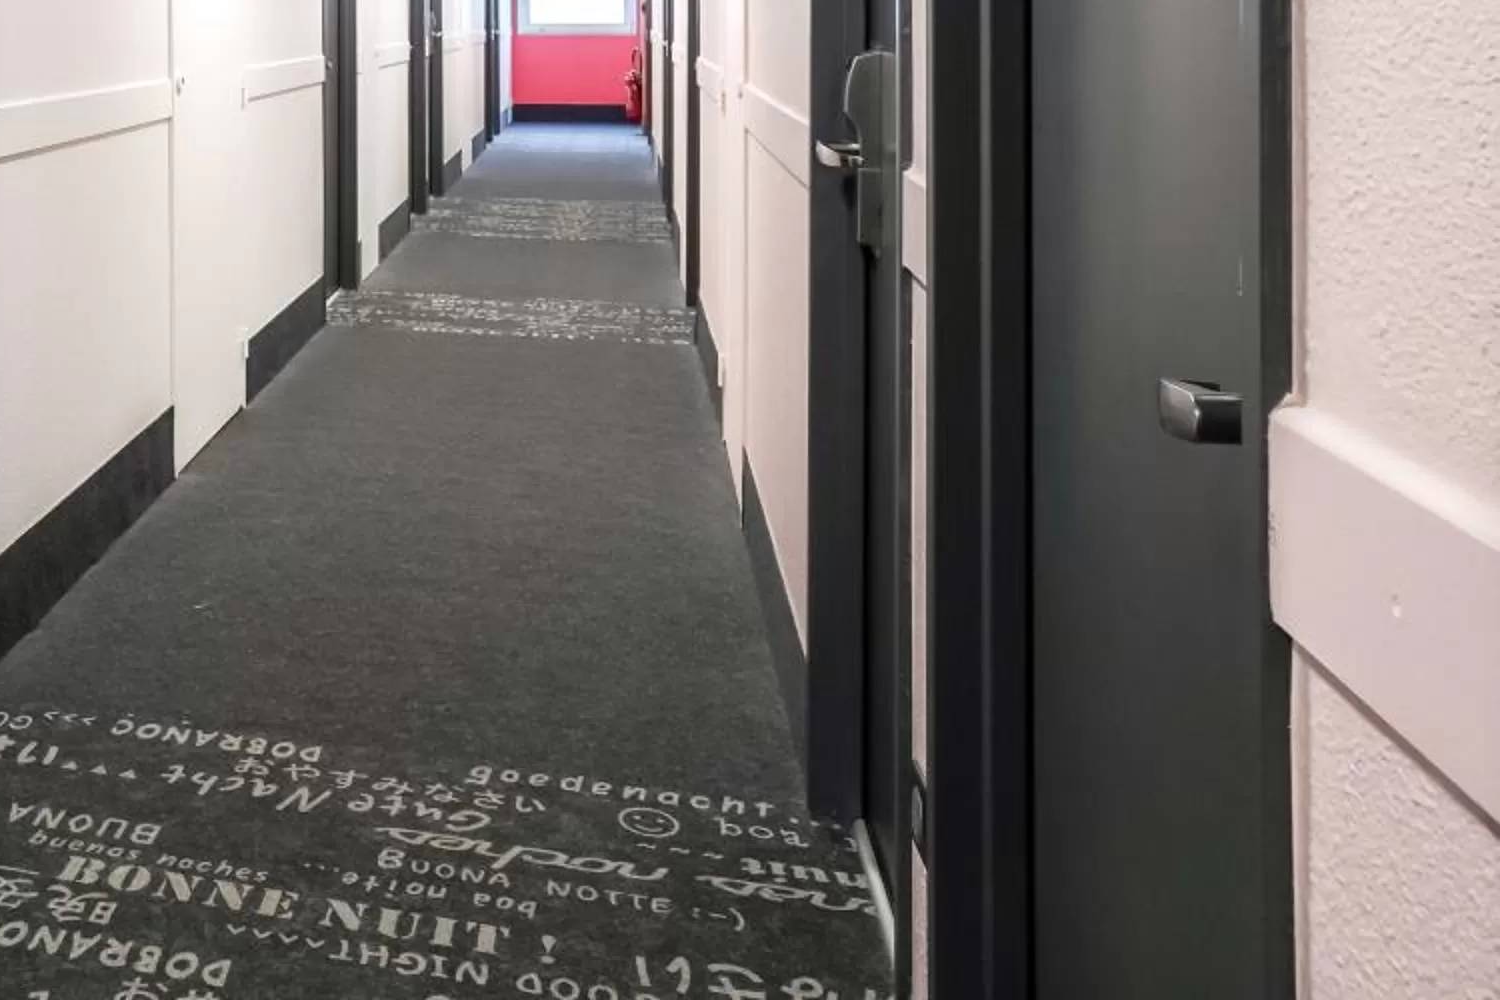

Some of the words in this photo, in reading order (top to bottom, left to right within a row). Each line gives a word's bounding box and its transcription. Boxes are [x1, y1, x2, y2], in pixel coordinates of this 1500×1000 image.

[110, 718, 324, 763] DOBRANOC
[160, 763, 334, 813] Nacht
[8, 801, 162, 845] BUONA
[348, 792, 492, 832] Gute
[55, 855, 300, 918] BONNE
[318, 898, 511, 955] NUIT
[376, 848, 511, 889] BUONA
[546, 879, 674, 915] NOTTE
[473, 891, 538, 921] boa
[327, 938, 490, 987] NIGHT
